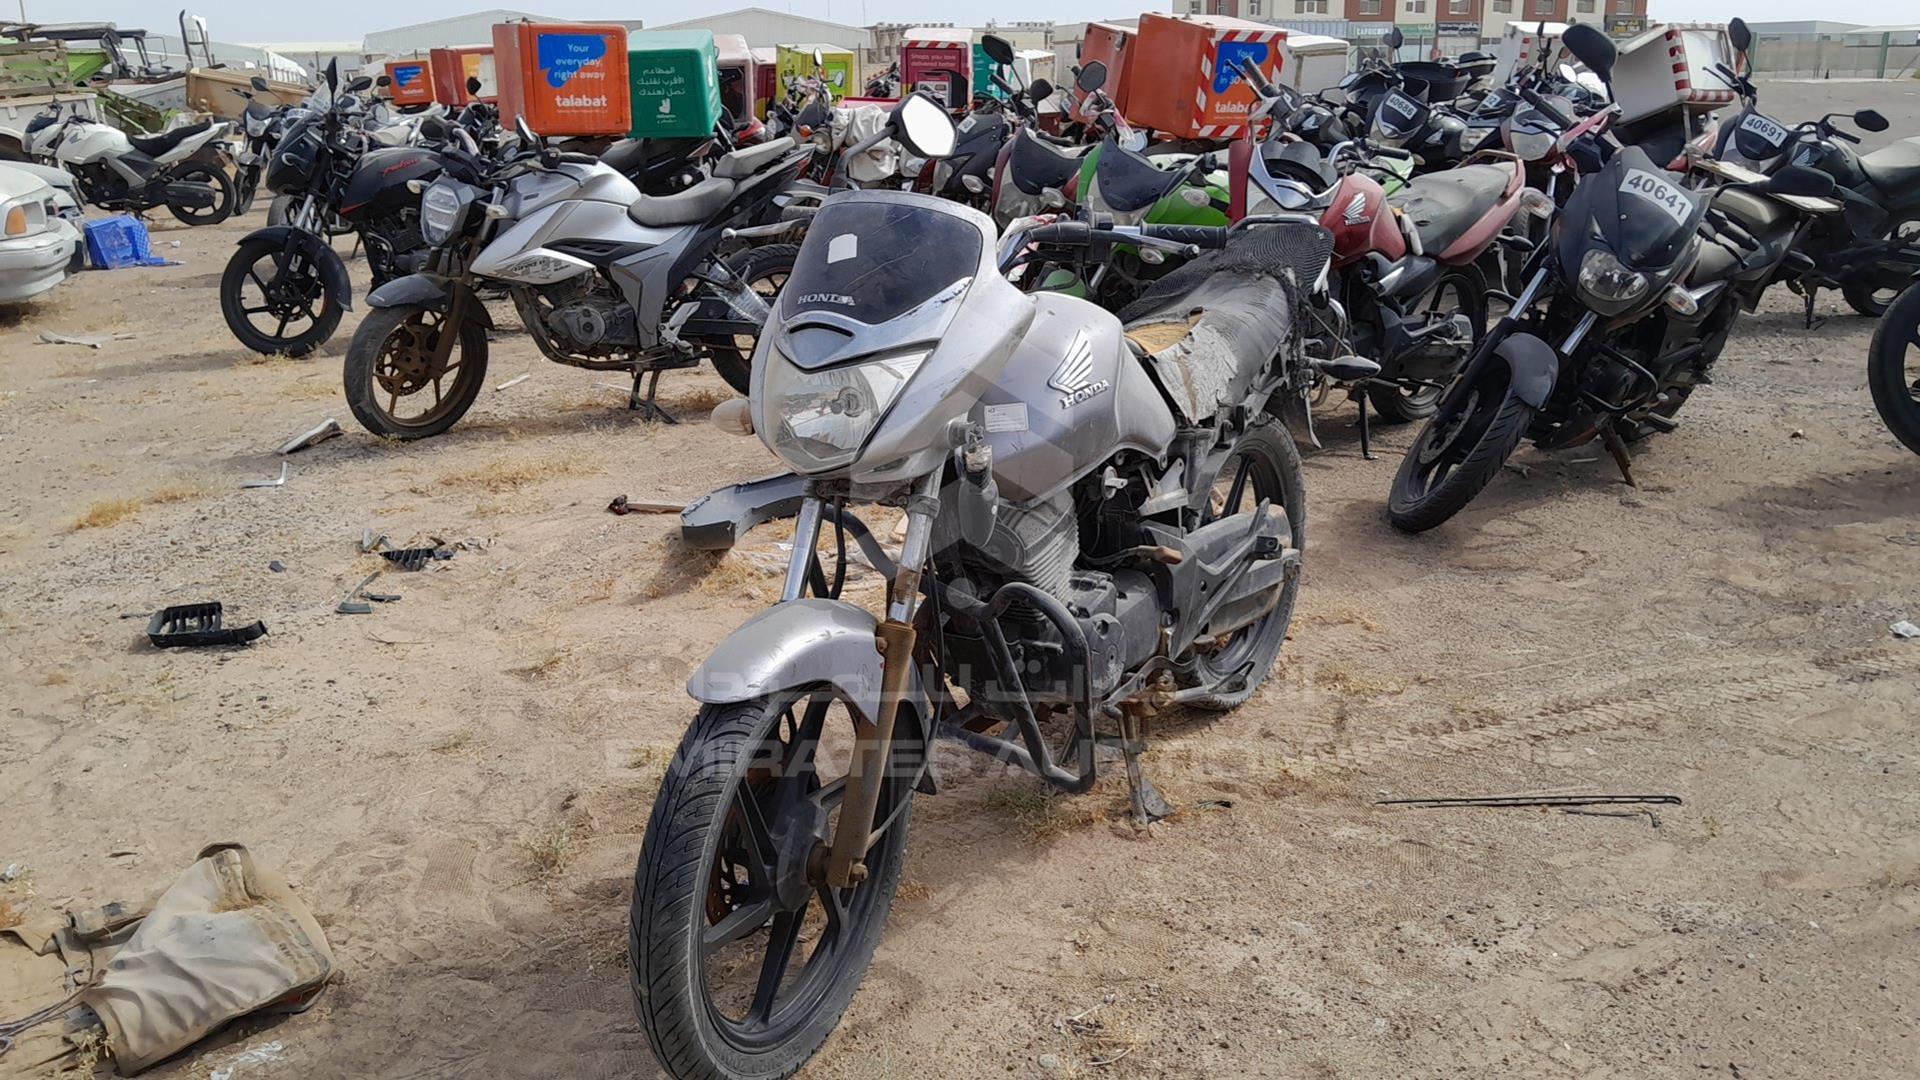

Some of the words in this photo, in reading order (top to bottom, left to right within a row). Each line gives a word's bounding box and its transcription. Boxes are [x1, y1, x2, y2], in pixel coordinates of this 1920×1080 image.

[567, 43, 589, 53] Your
[554, 70, 577, 81] right
[554, 94, 608, 107] talabat
[1389, 96, 1414, 116] 40686
[1746, 118, 1783, 142] 40691
[1628, 174, 1686, 216] 40641
[797, 293, 856, 306] HONDA
[1060, 379, 1111, 409] HONDA
